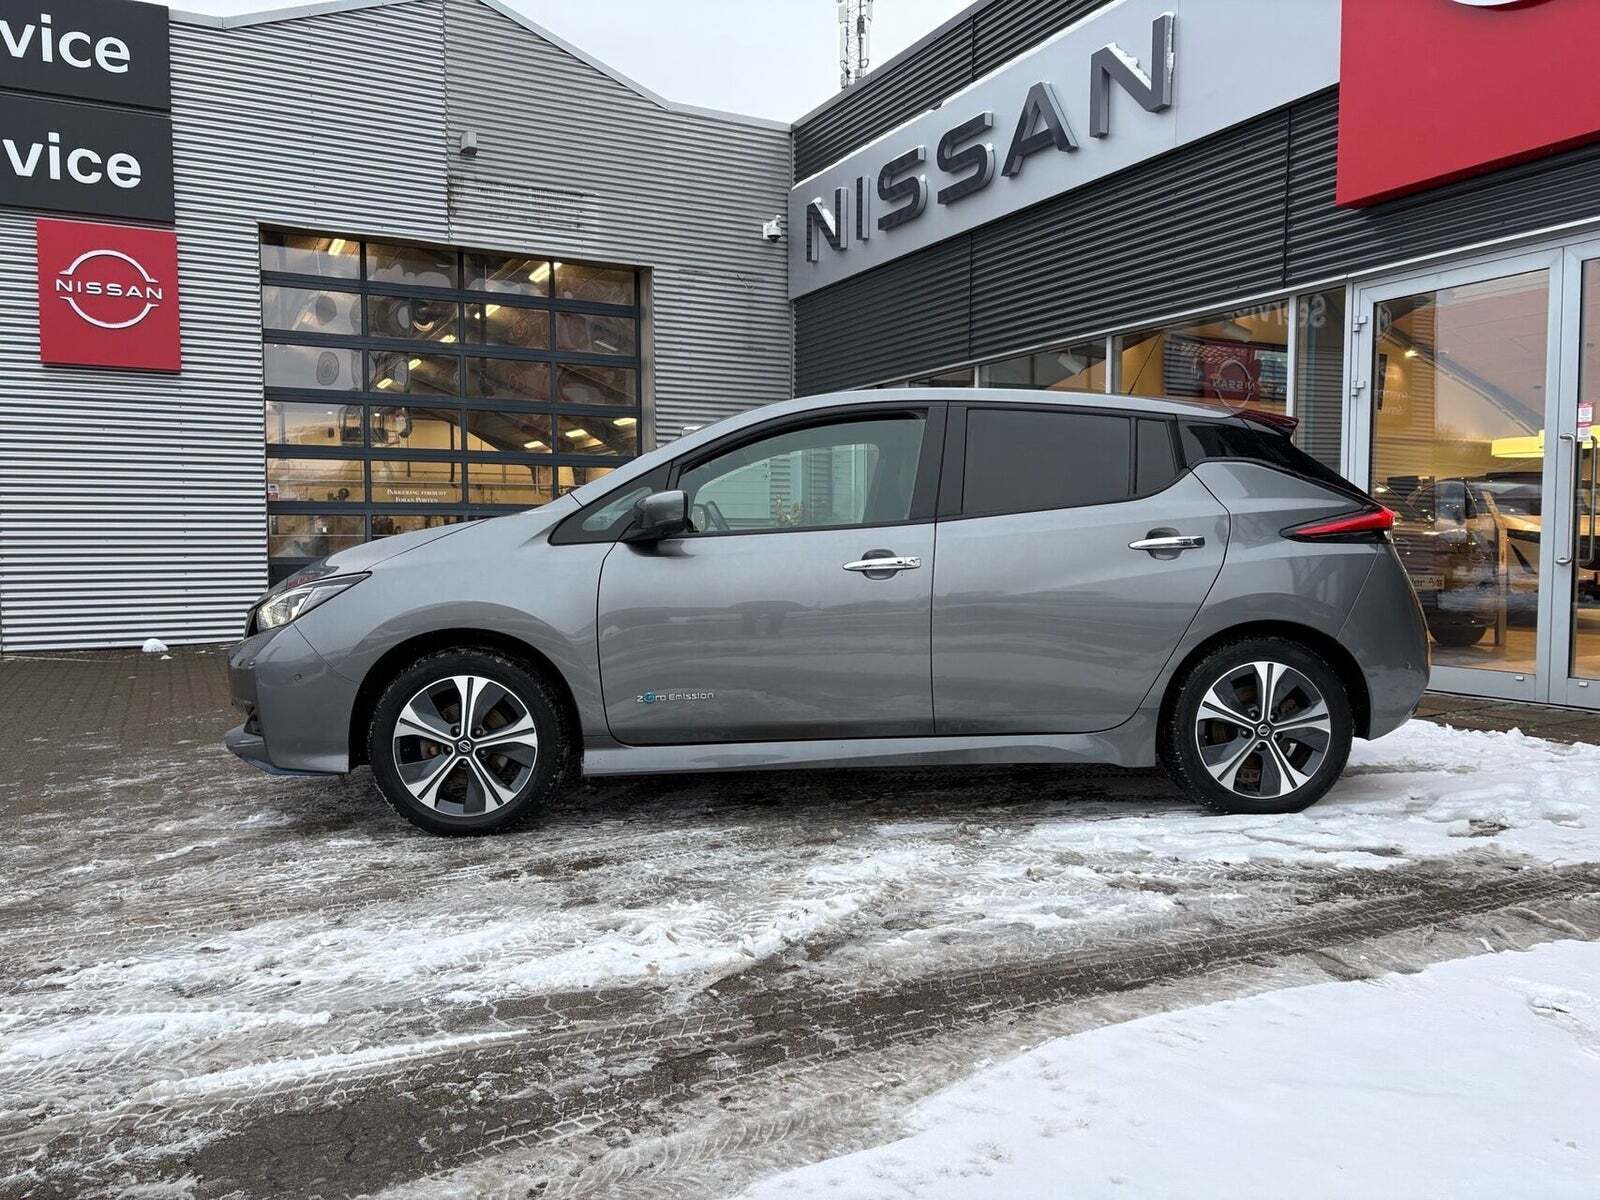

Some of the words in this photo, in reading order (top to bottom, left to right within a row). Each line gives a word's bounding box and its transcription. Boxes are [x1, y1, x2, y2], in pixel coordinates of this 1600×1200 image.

[0, 13, 131, 73] vice
[2, 132, 142, 189] vice
[806, 11, 1175, 263] NISSAN
[55, 278, 163, 300] NISSAN
